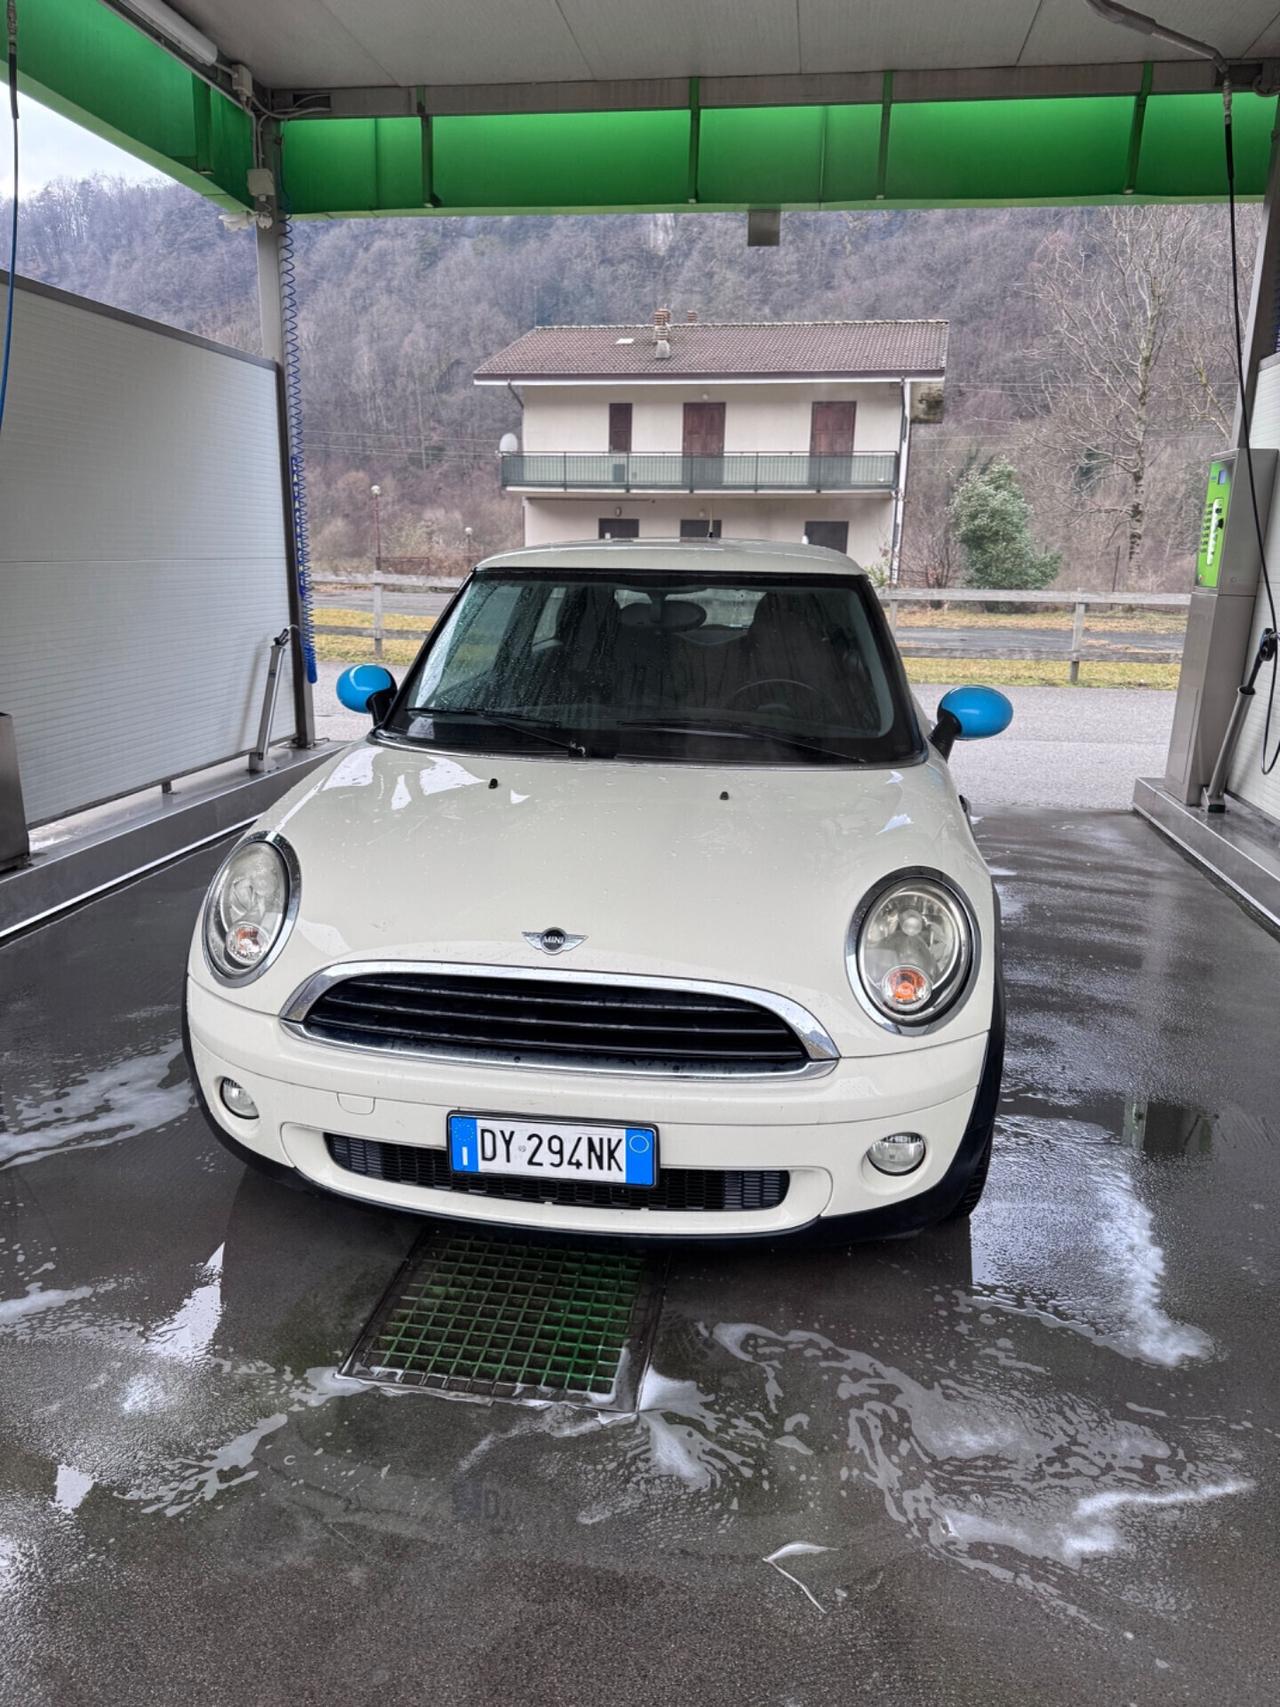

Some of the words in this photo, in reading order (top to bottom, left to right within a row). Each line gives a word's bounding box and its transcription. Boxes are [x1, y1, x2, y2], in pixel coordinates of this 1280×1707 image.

[543, 935, 565, 944] MINI
[480, 1128, 515, 1163] DY
[462, 1146, 469, 1166] I
